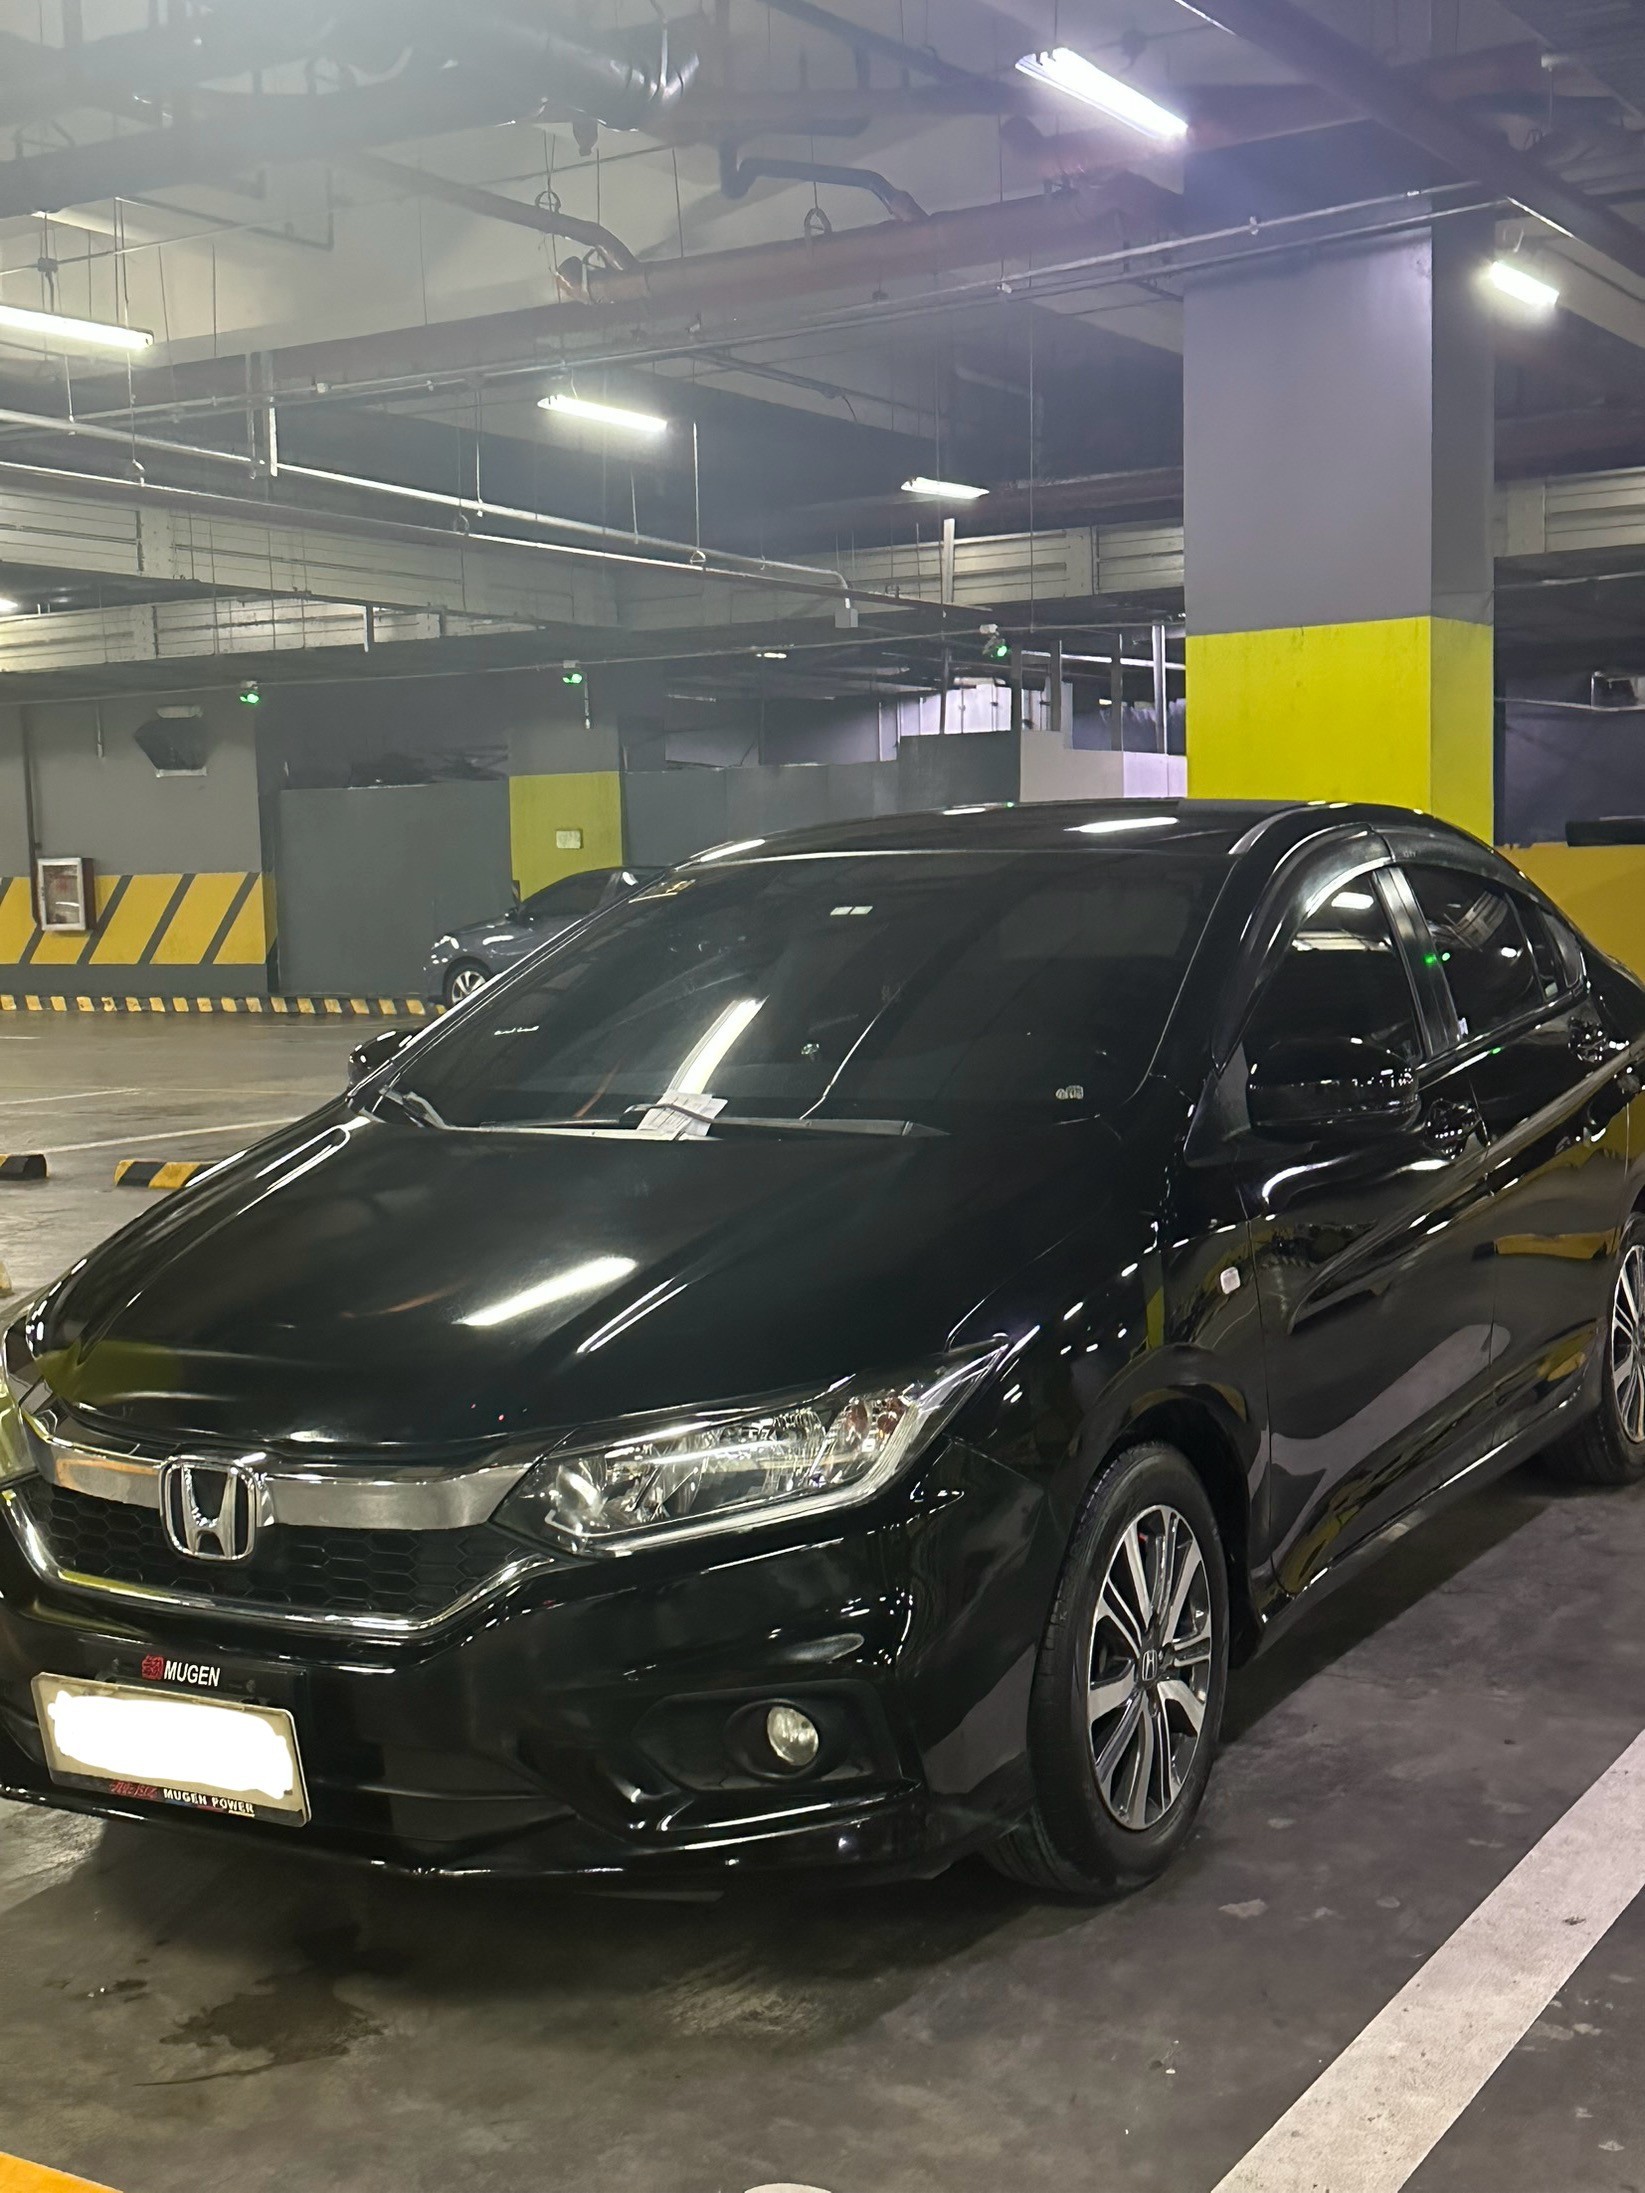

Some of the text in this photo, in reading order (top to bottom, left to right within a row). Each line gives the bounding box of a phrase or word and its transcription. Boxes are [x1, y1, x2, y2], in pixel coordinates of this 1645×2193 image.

[164, 1660, 221, 1687] MUGEN
[163, 1788, 208, 1806] MUGEN
[211, 1796, 254, 1814] POWER
